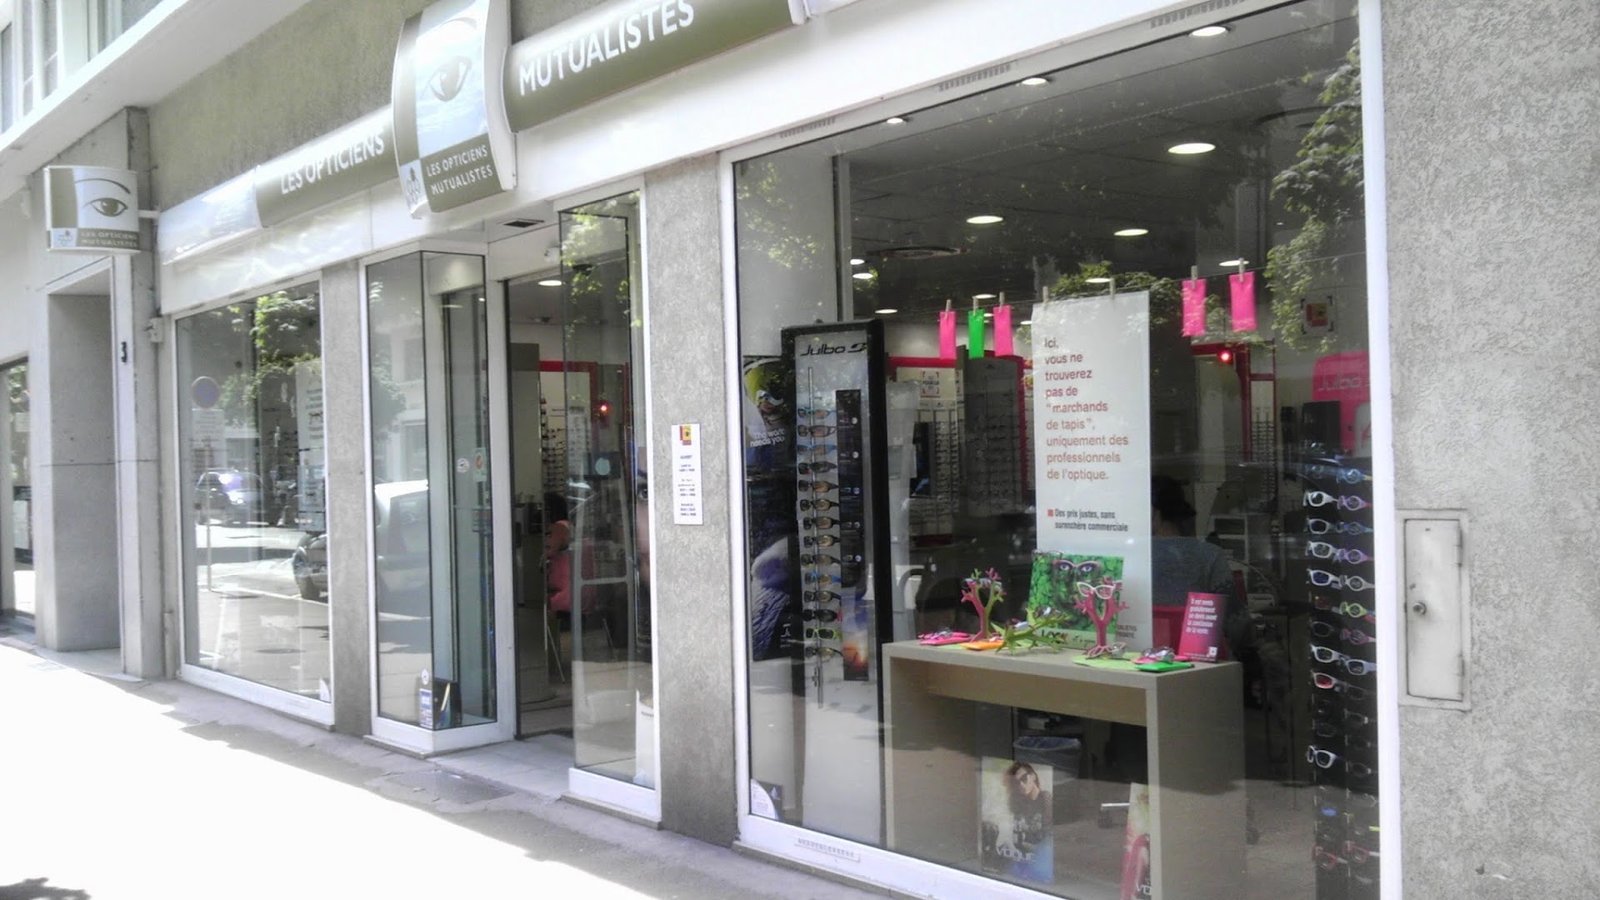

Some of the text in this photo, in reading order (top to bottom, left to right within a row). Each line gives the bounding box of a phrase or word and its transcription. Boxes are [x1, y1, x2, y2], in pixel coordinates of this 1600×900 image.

[518, 0, 695, 96] MUTUALISTES
[281, 134, 385, 195] LES OPTICIENS
[426, 144, 489, 177] LES OPTICIENS
[430, 164, 493, 195] MUTUALISTES
[800, 343, 846, 357] Julbo
[1044, 338, 1059, 349] Ici,
[1044, 353, 1083, 365] vous ne
[1045, 369, 1093, 381] trouverez
[1045, 386, 1078, 399] pas de
[1046, 419, 1059, 430] de
[1046, 435, 1129, 448] uniquement des
[1046, 451, 1121, 465] professionnels
[1046, 469, 1109, 482] de l'optique.
[1067, 509, 1078, 519] prix
[1079, 509, 1100, 520] justes,
[1101, 510, 1116, 519] sans
[1088, 521, 1129, 532] commerciale
